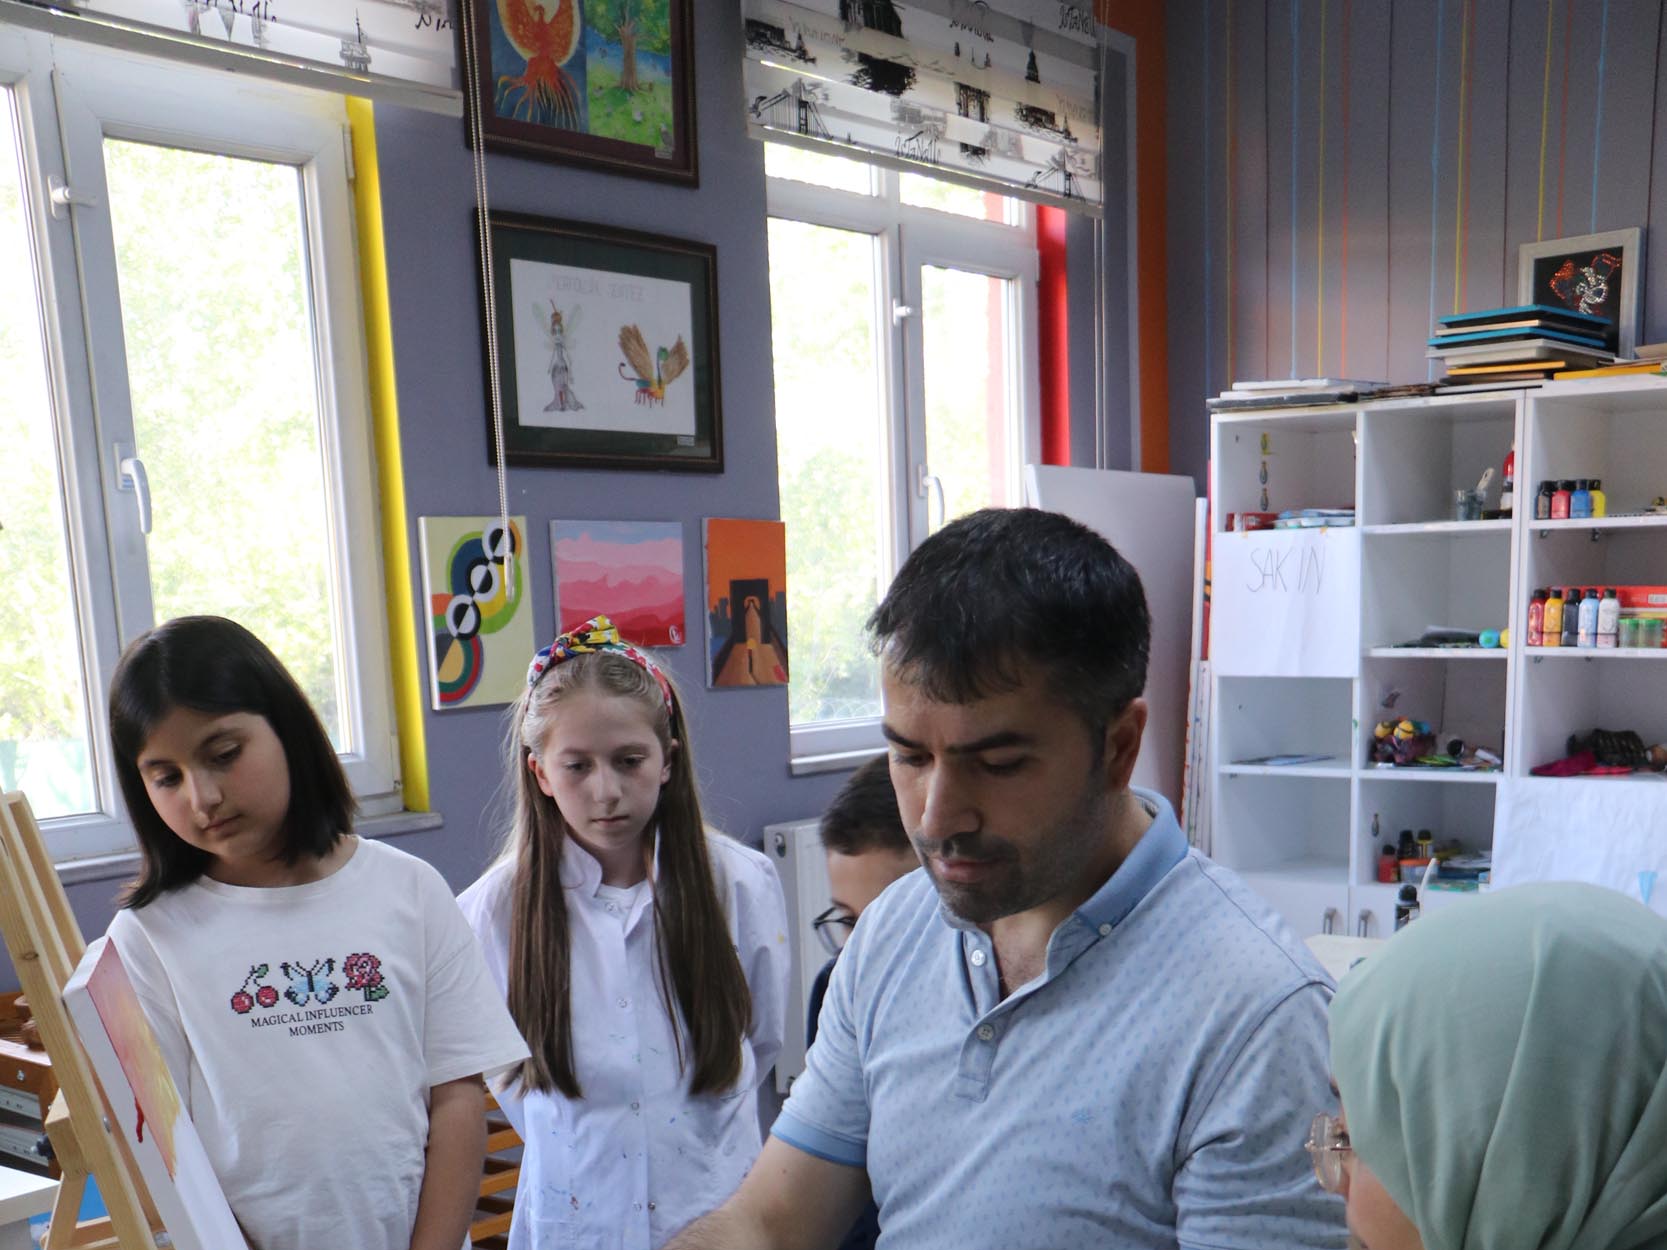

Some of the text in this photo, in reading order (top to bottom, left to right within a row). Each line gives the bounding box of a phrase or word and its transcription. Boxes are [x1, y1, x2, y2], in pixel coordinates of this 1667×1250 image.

[251, 1004, 374, 1028] MAGICAL INFLUENCER
[288, 1020, 345, 1037] MOMENTS
